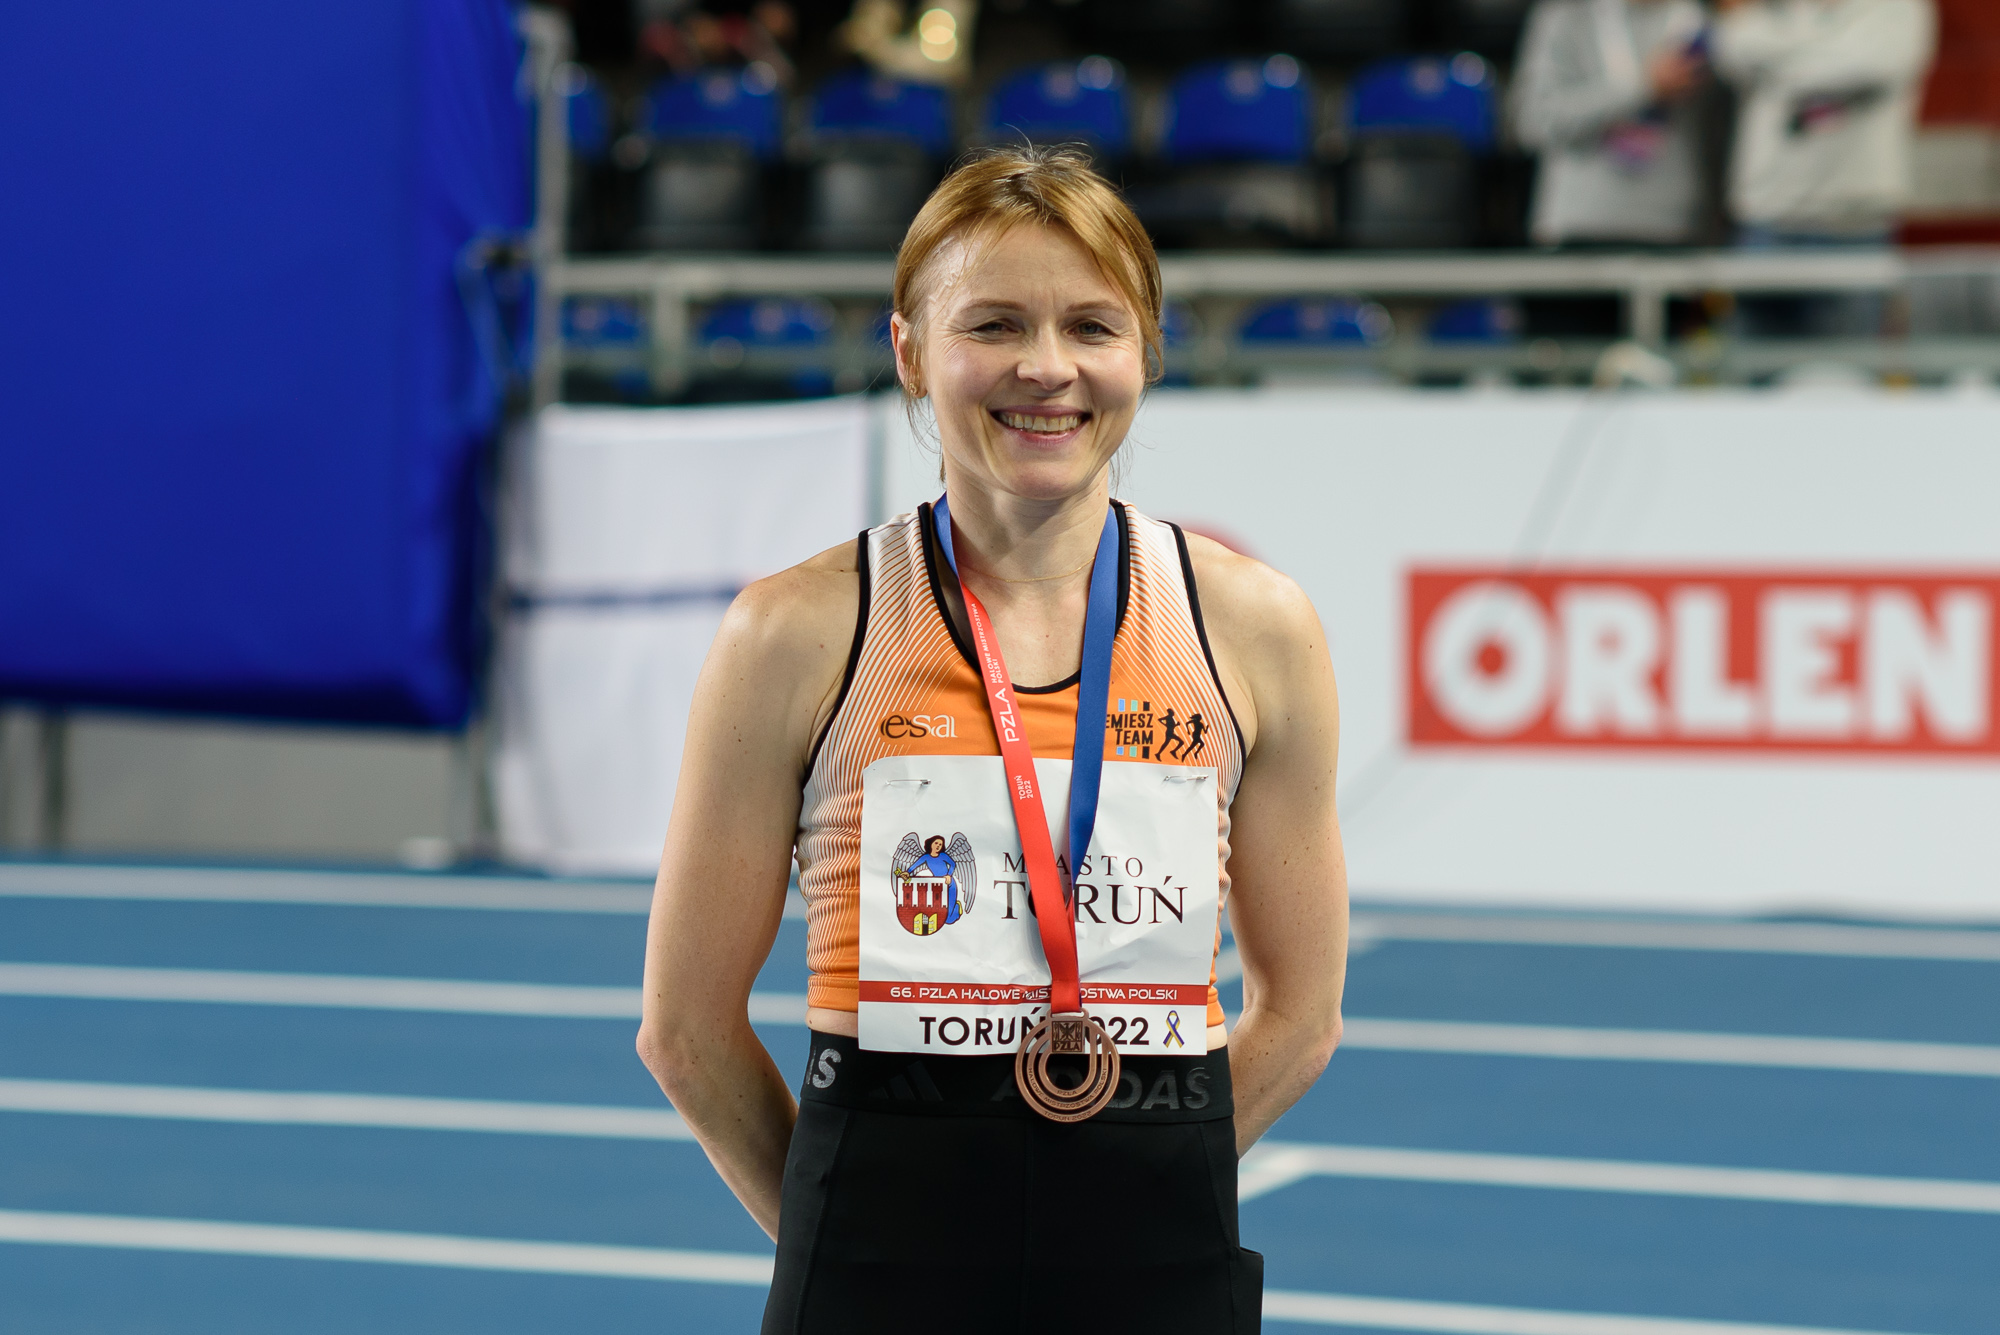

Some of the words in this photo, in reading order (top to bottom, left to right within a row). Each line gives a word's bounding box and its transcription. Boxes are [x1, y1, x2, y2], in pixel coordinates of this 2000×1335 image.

[985, 653, 998, 684] HALOWE
[992, 658, 1004, 684] POLSKI
[1422, 577, 1988, 742] ORLEN
[881, 714, 958, 739] esa
[995, 688, 1020, 743] PZLA
[1115, 729, 1153, 745] TEAM
[1014, 775, 1026, 800] TORUŃ
[1024, 780, 1034, 799] 2022
[1002, 851, 1143, 878] MASTO
[890, 986, 916, 999] 66.
[919, 987, 958, 1000] PZLA
[961, 988, 1020, 1000] HALOWE
[1022, 987, 1126, 1000] MISOSTWA
[1128, 988, 1177, 1000] POLSKI
[1084, 1016, 1149, 1046] 022
[1053, 1041, 1080, 1051] PZLA
